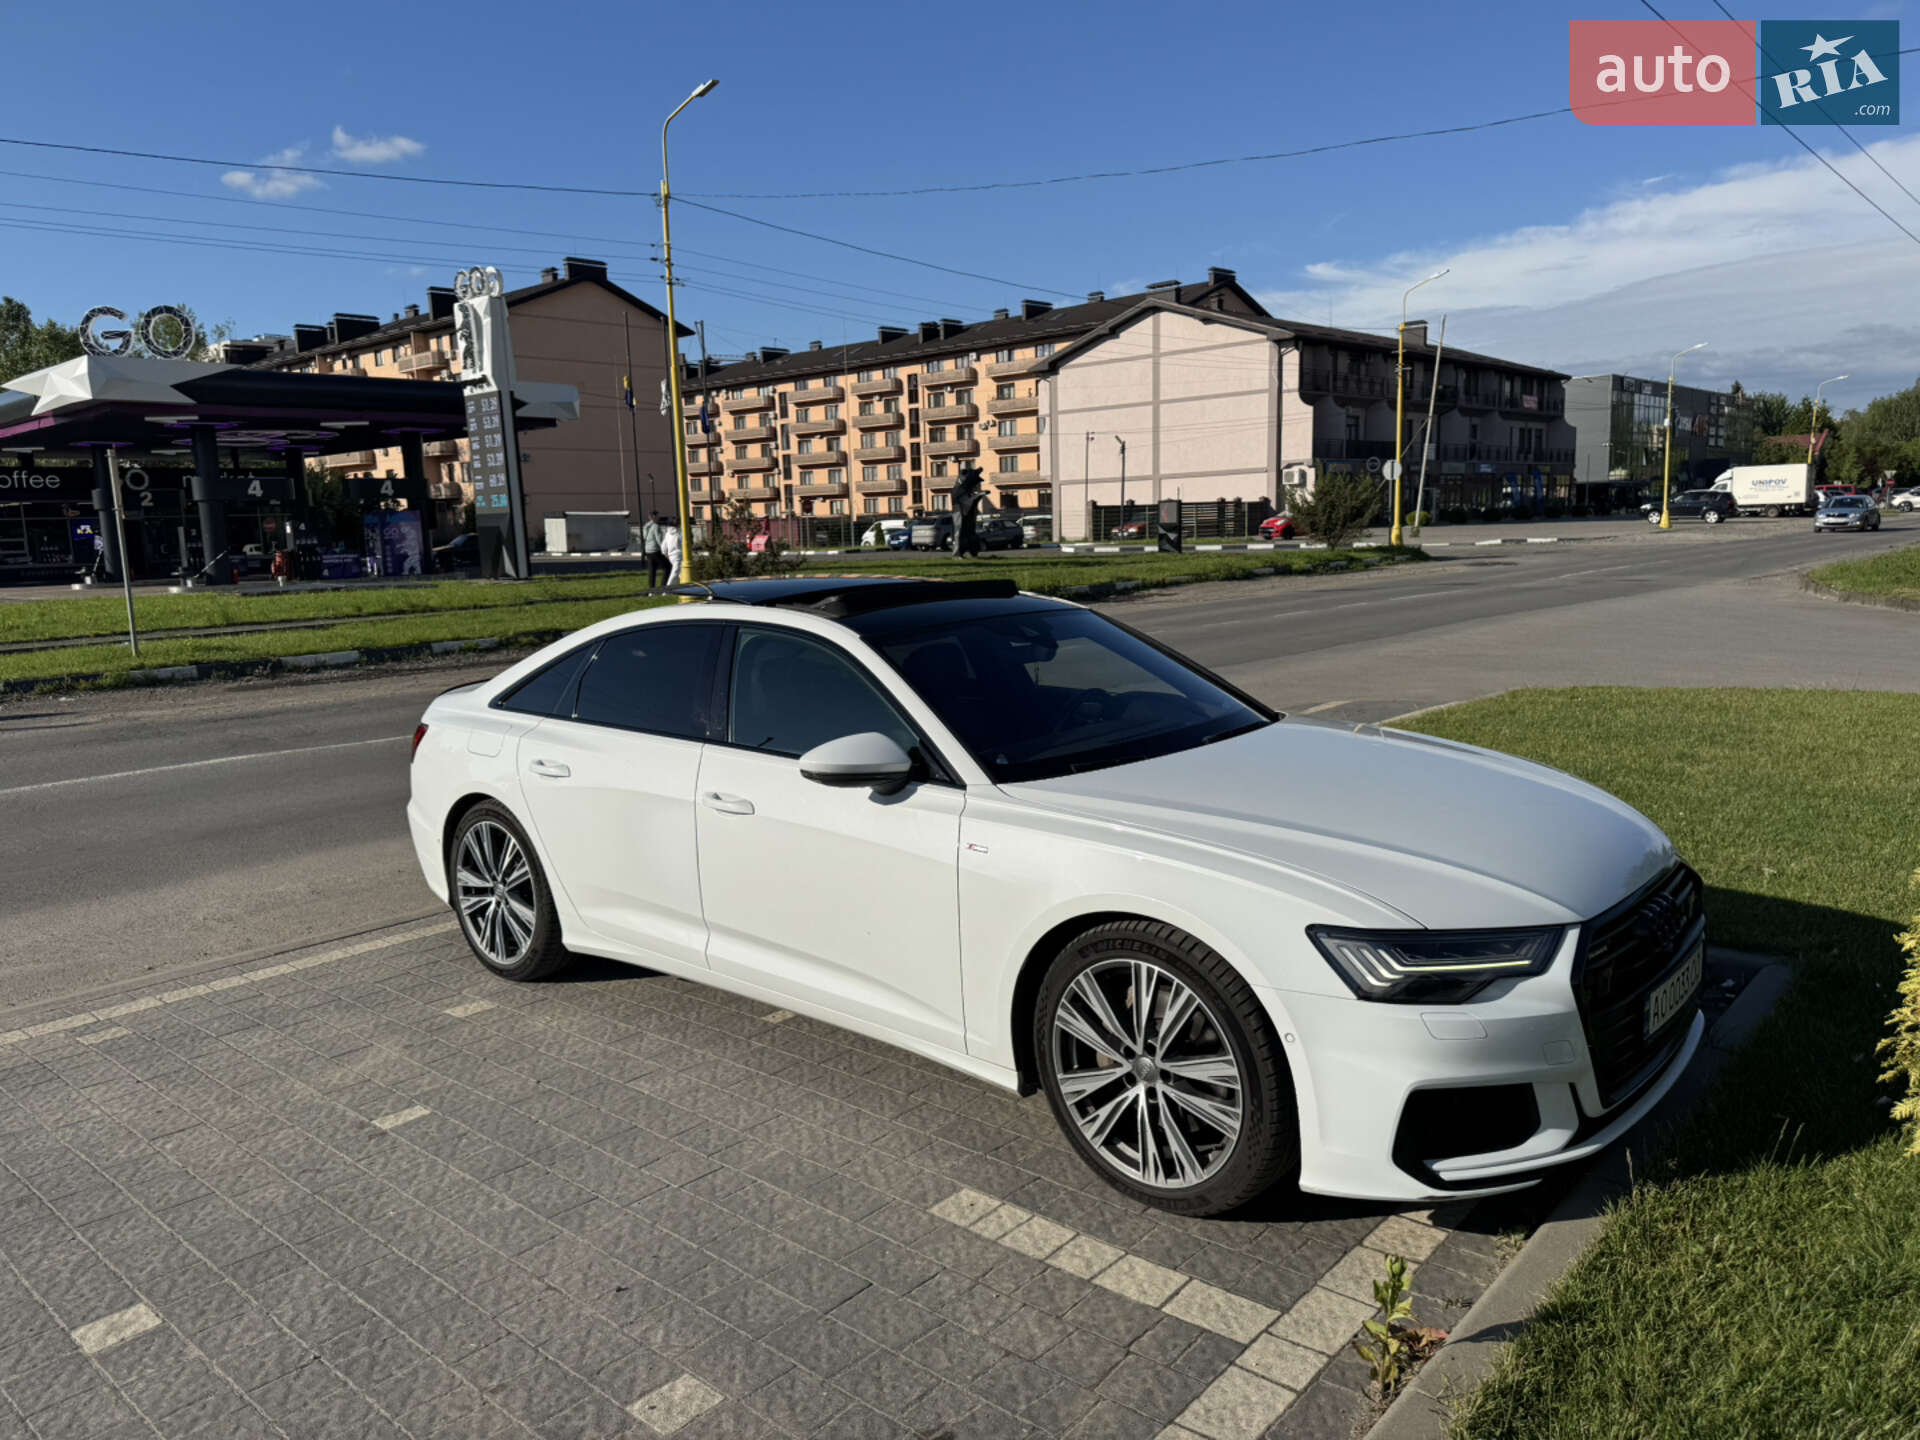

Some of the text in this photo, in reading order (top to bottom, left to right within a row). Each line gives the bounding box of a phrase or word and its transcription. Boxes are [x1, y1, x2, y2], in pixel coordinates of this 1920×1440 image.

[79, 305, 195, 360] GO
[248, 480, 263, 497] 4
[380, 480, 394, 496] 4
[140, 491, 154, 506] 2
